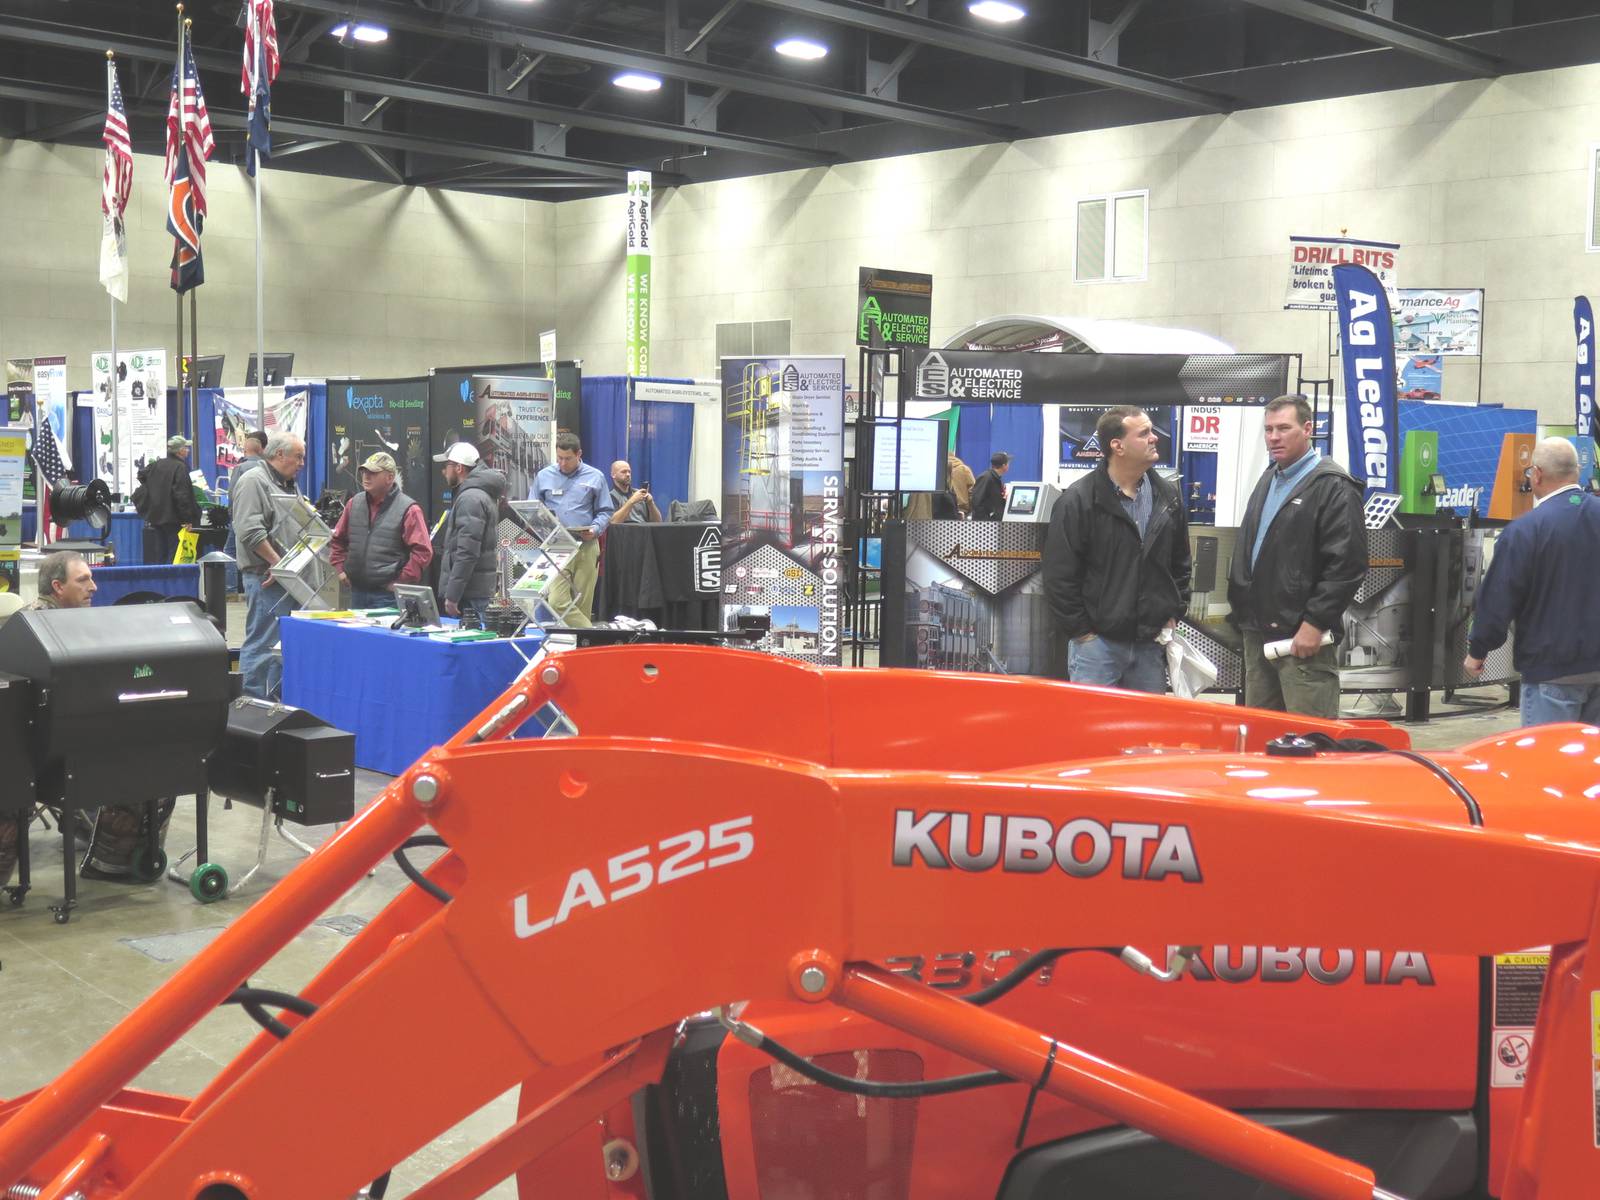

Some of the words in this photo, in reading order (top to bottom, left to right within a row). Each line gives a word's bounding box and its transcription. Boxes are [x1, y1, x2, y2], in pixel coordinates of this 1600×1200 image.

[628, 200, 636, 248] AgriGold
[639, 199, 649, 248] AgriGold
[1294, 246, 1349, 264] DRILL
[1352, 249, 1394, 269] BITS
[639, 274, 648, 294] WE
[1293, 279, 1325, 289] broken
[639, 300, 649, 342] KNOW
[881, 313, 929, 325] AUTOMATED
[1349, 289, 1377, 345] Ag
[882, 322, 892, 341] &
[891, 323, 928, 335] ELECTRIC
[896, 333, 928, 344] SERVICE
[950, 368, 1023, 379] AUTOMATED
[800, 380, 809, 391] &
[950, 378, 966, 397] &
[965, 378, 1022, 389] ELECTRIC
[971, 388, 1022, 399] SERVICE
[353, 394, 385, 414] exapta
[822, 475, 839, 555] SERVICE
[822, 557, 839, 657] SOLUTION
[892, 808, 1204, 883] KUBOTA
